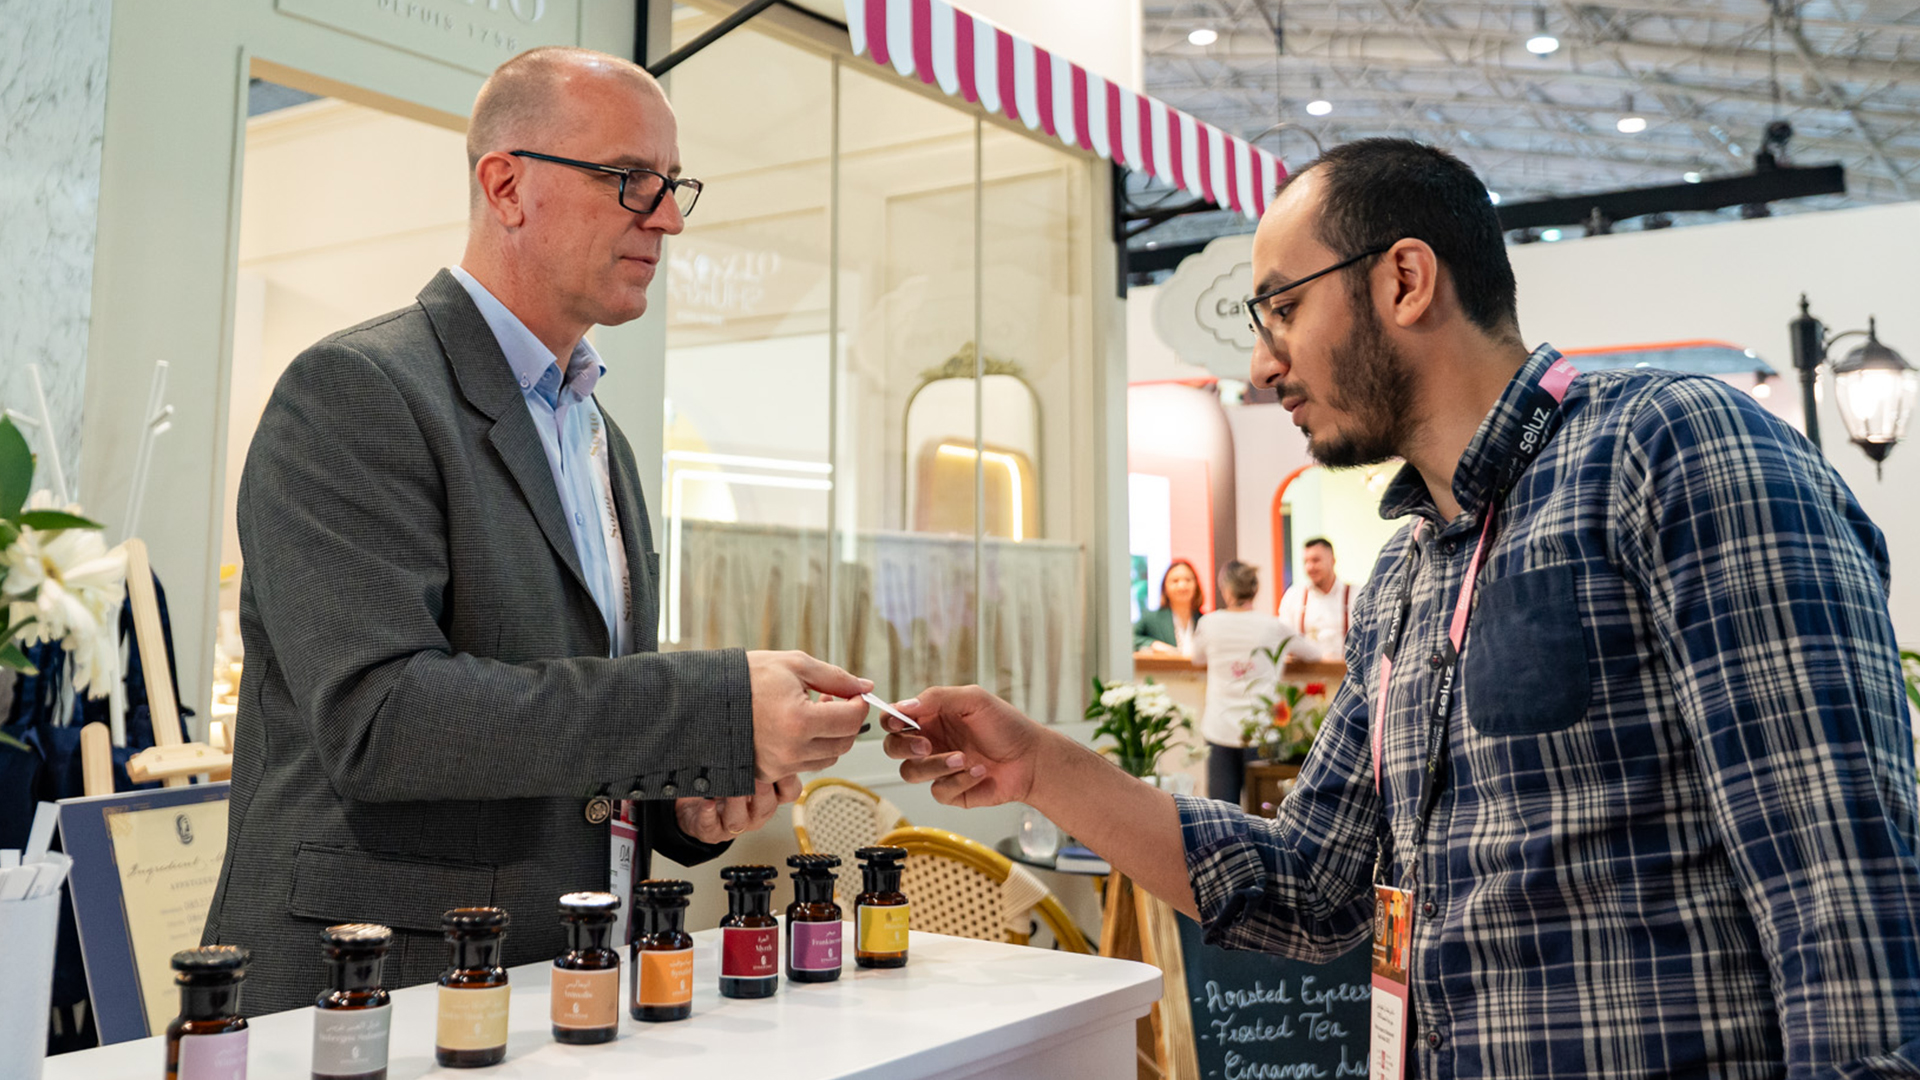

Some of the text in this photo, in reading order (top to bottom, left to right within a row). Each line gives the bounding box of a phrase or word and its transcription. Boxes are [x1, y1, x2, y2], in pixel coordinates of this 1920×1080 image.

[1215, 294, 1250, 317] Caf
[1205, 979, 1294, 1013] Roasted
[1211, 1012, 1297, 1046] Frosted
[1299, 1012, 1350, 1042] Tea
[1224, 1049, 1330, 1080] Cinnamon
